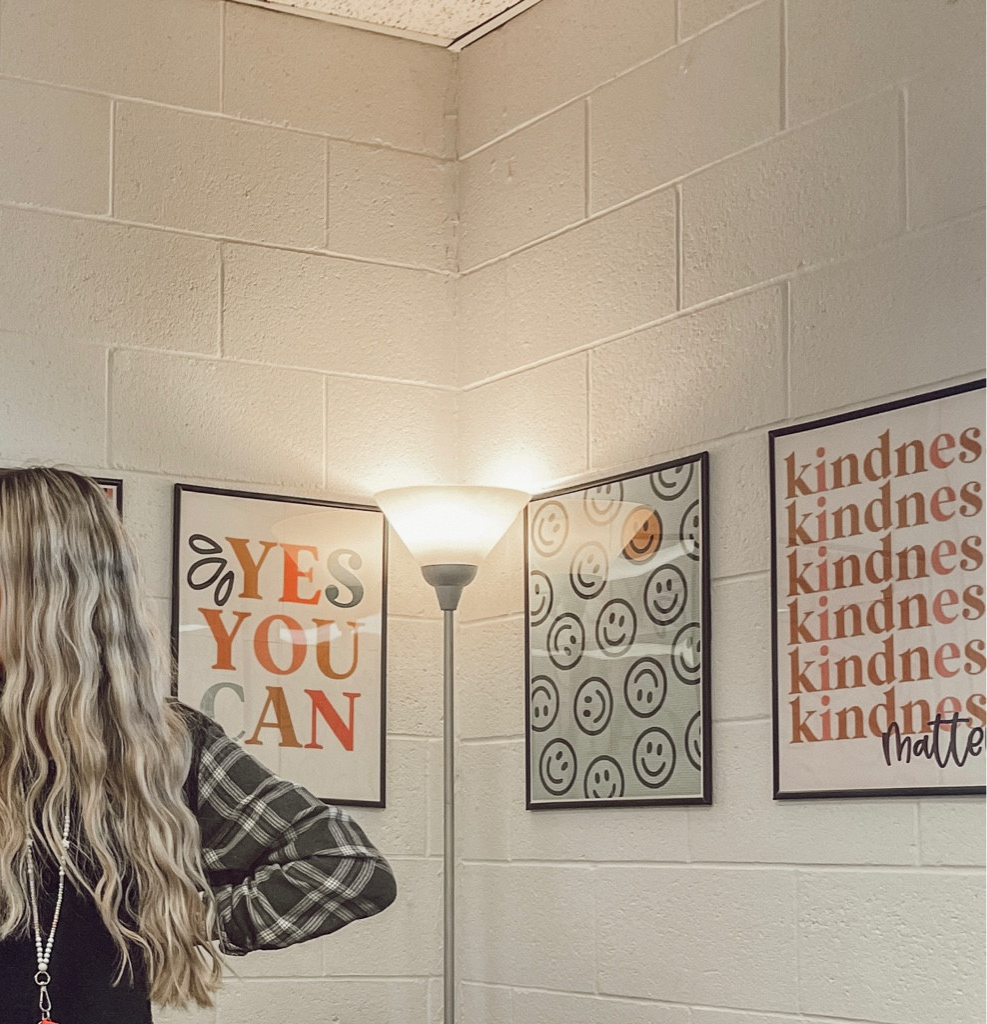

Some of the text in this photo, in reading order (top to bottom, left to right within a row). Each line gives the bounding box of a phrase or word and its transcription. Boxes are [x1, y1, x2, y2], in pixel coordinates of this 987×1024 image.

[784, 428, 983, 500] kindnes
[785, 480, 983, 548] kindnes
[225, 536, 364, 609] YES
[786, 532, 984, 597] kindnes
[197, 607, 364, 680] YOU
[787, 584, 986, 646] kindnes
[200, 681, 361, 752] CAN
